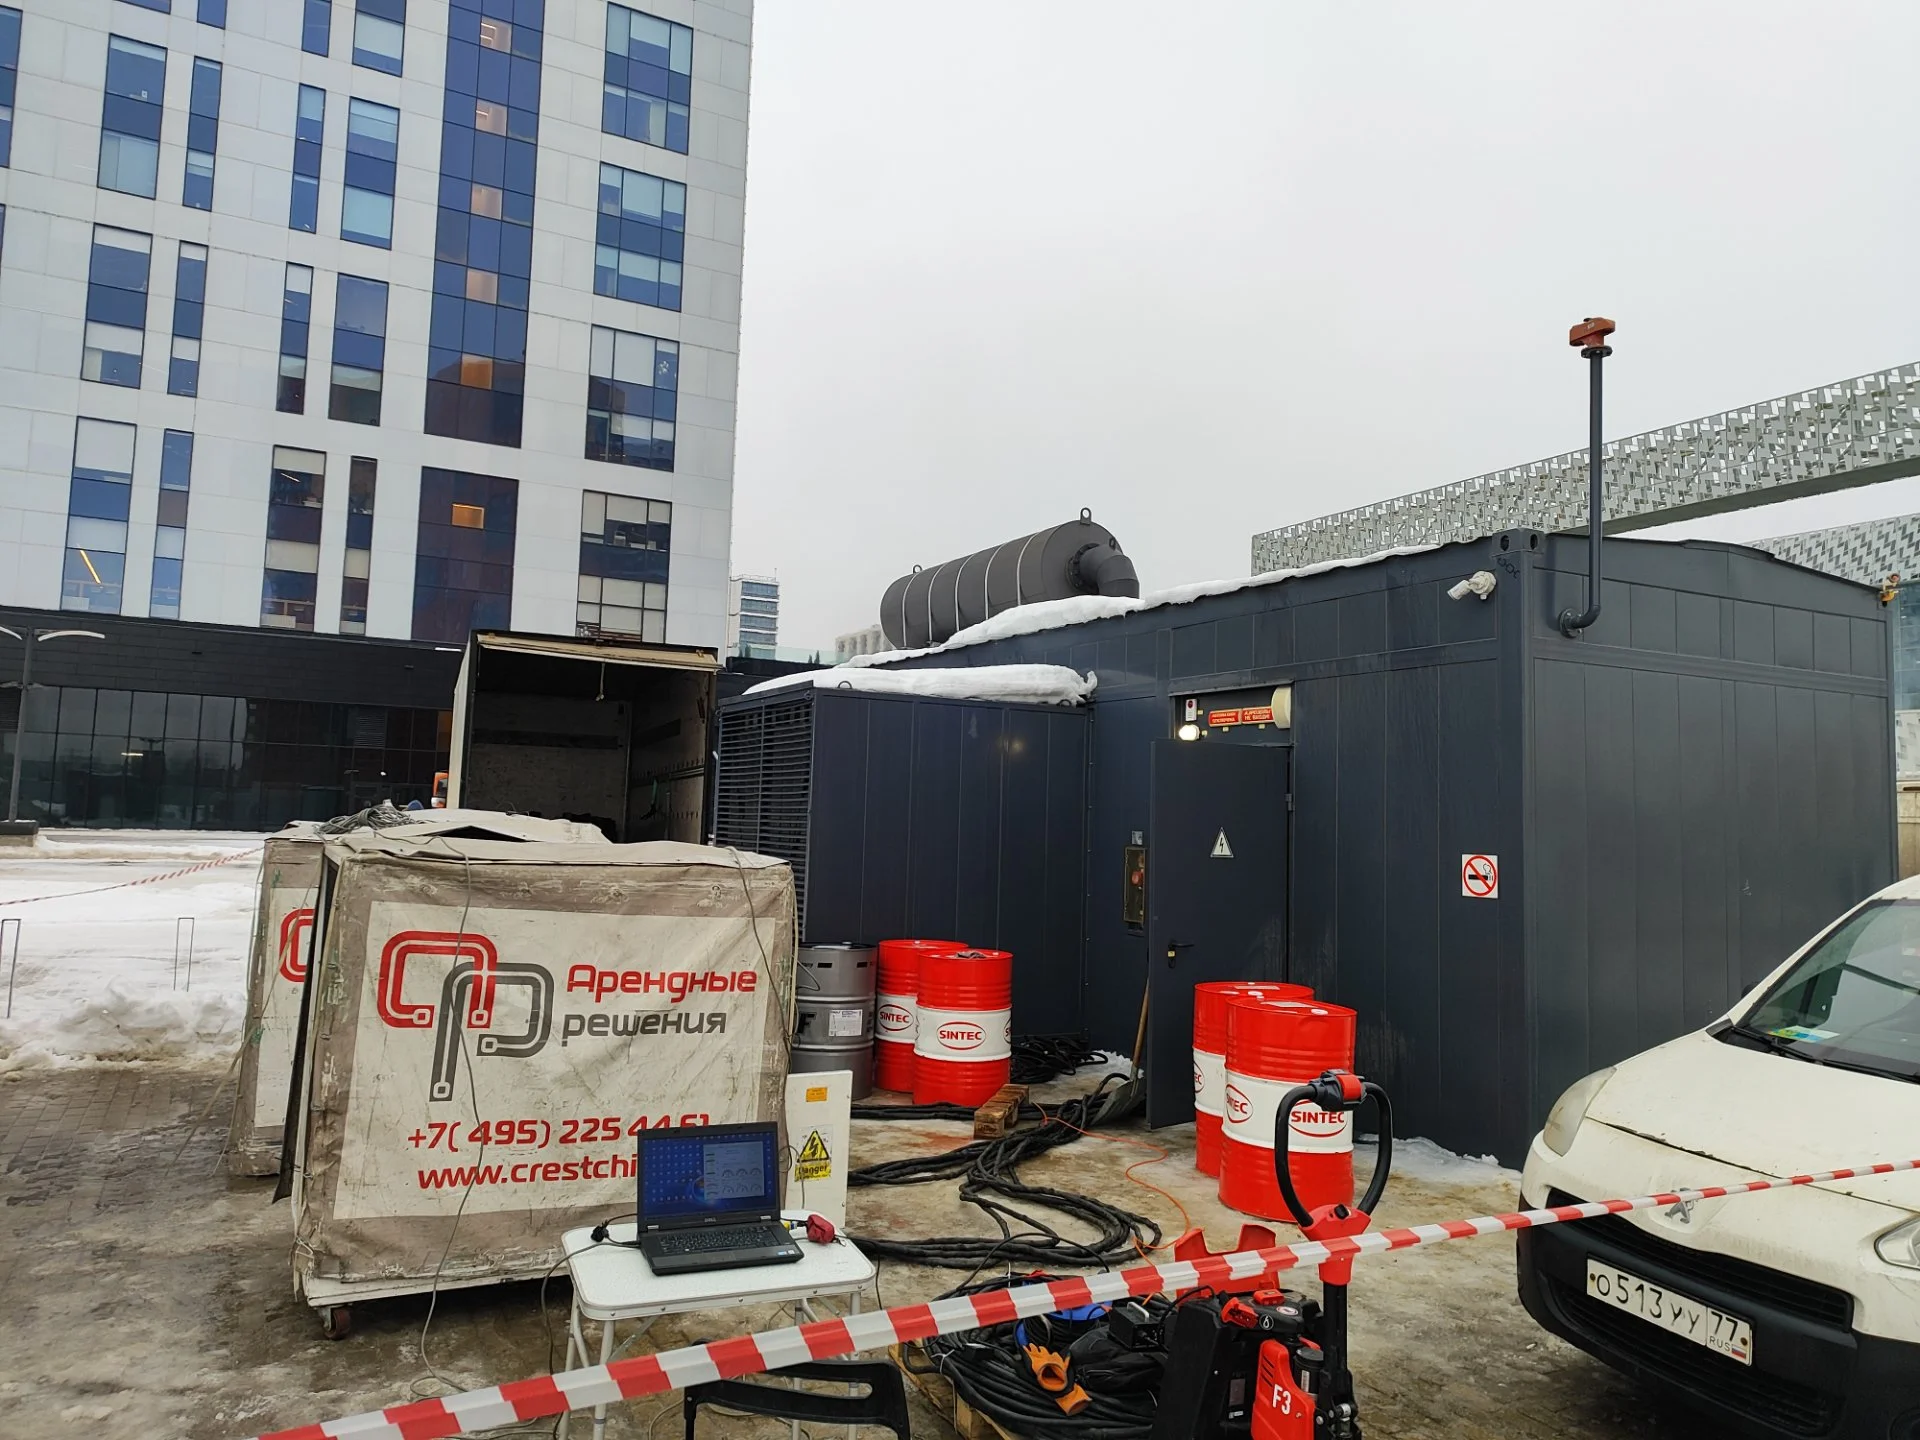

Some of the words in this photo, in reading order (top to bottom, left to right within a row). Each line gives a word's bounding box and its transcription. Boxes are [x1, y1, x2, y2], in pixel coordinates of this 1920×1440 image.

[567, 964, 758, 1004] Арендные
[561, 1012, 727, 1048] решения
[879, 1011, 910, 1023] SINTEC
[939, 1030, 982, 1041] SINTEC
[558, 1117, 622, 1145] 225
[1291, 1110, 1345, 1124] SINTEC
[418, 1153, 638, 1189] www.crestchi
[1711, 1311, 1739, 1341] 77
[1709, 1335, 1731, 1352] RUS
[1272, 1384, 1292, 1415] F3
